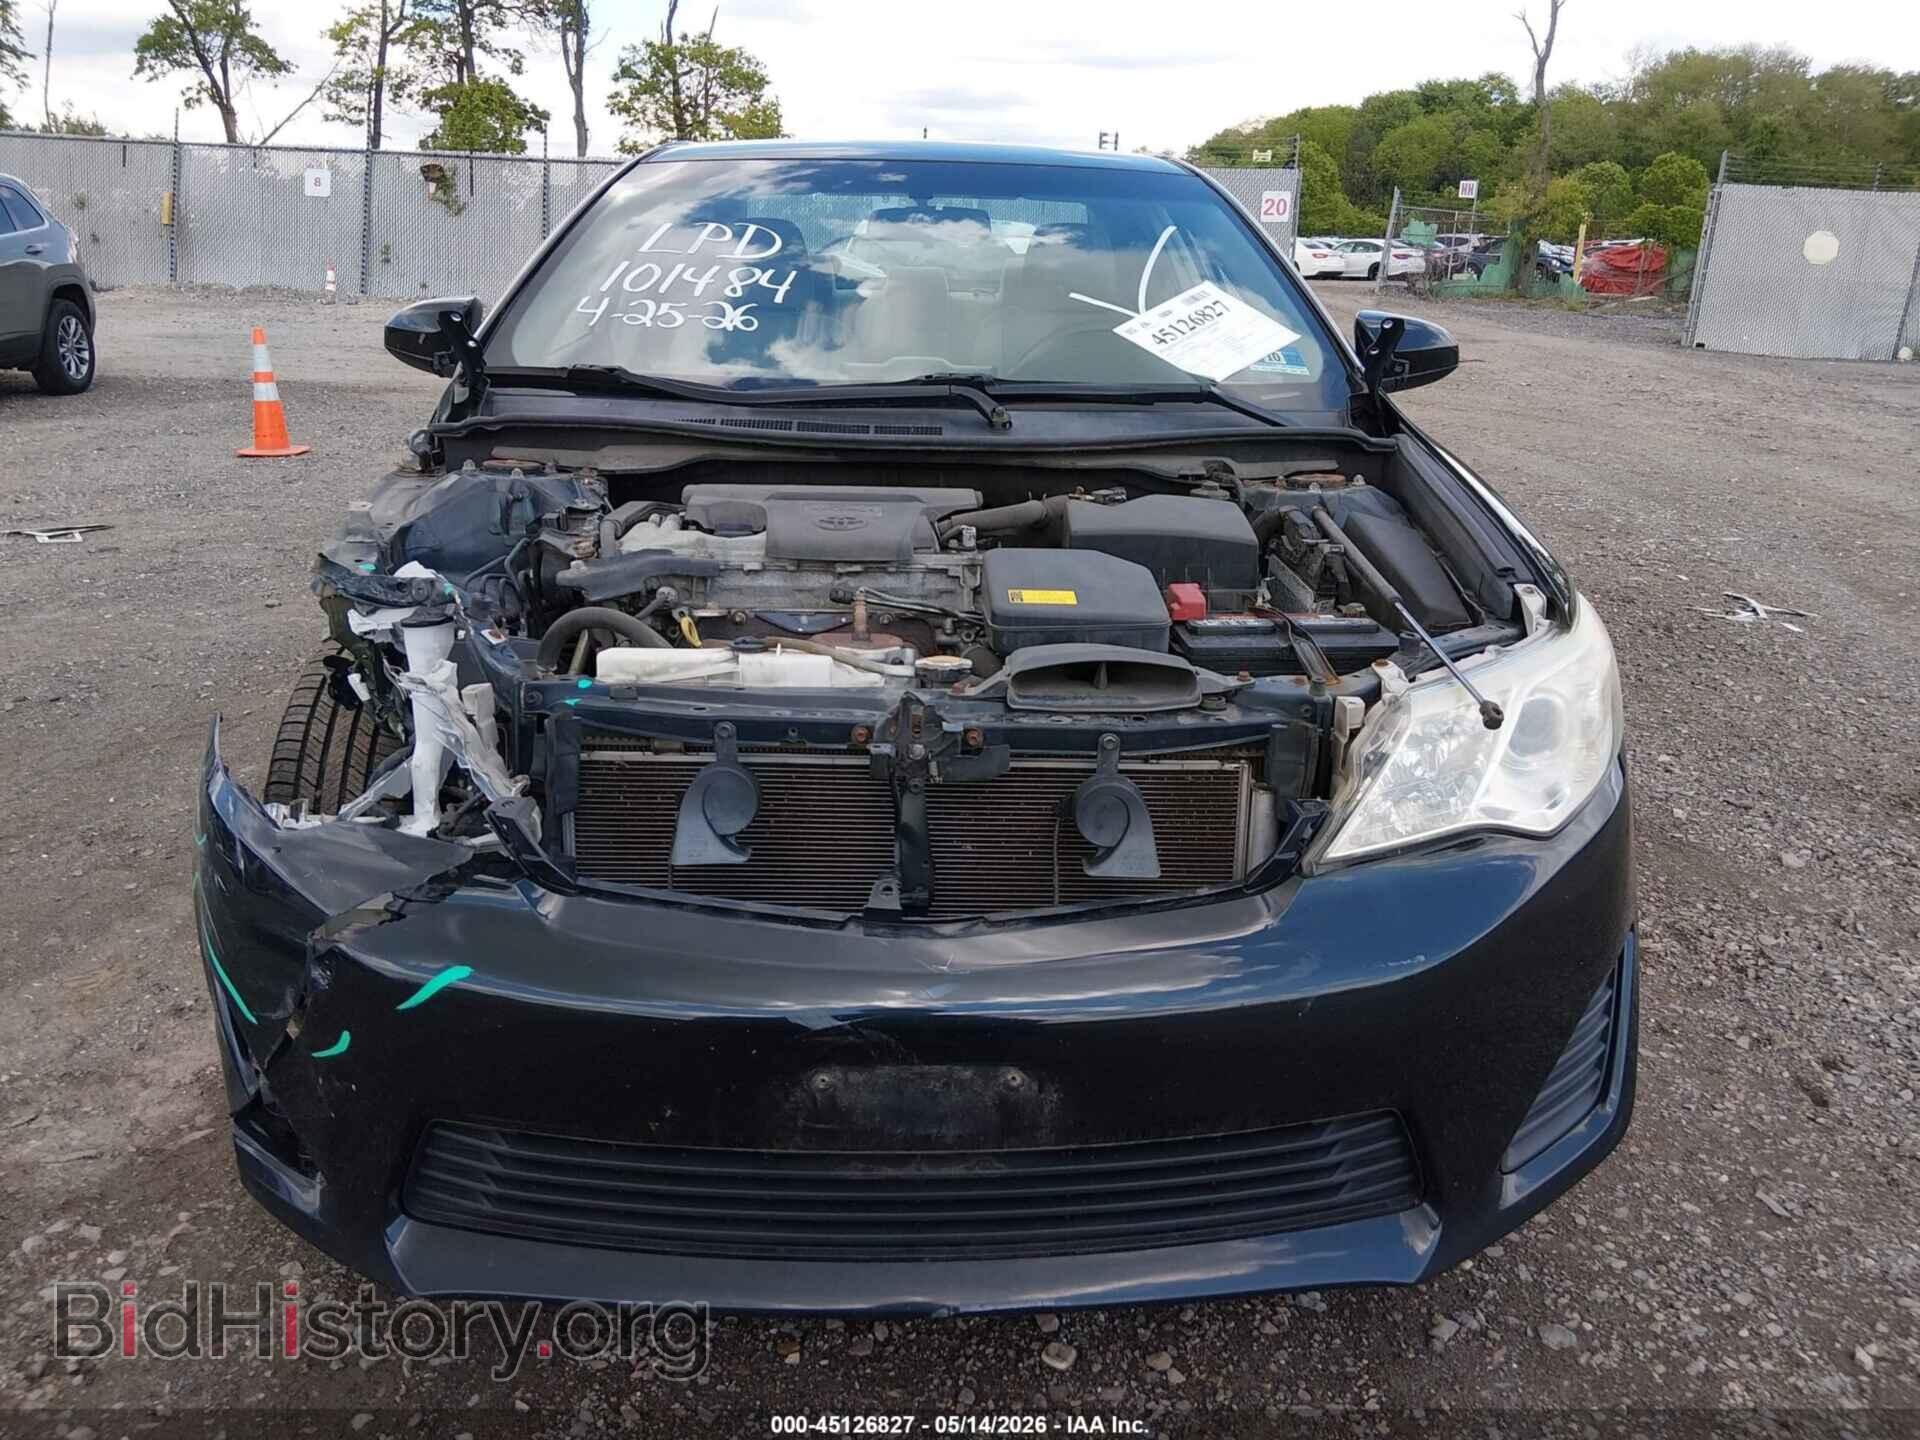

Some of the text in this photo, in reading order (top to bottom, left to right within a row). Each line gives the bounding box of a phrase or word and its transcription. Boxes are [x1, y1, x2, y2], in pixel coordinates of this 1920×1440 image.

[313, 176, 322, 188] 8
[1263, 198, 1288, 217] 20
[637, 222, 783, 261] LPD
[599, 261, 798, 304] 101484
[576, 295, 759, 331] 4-25-26
[1151, 300, 1231, 345] 45126827
